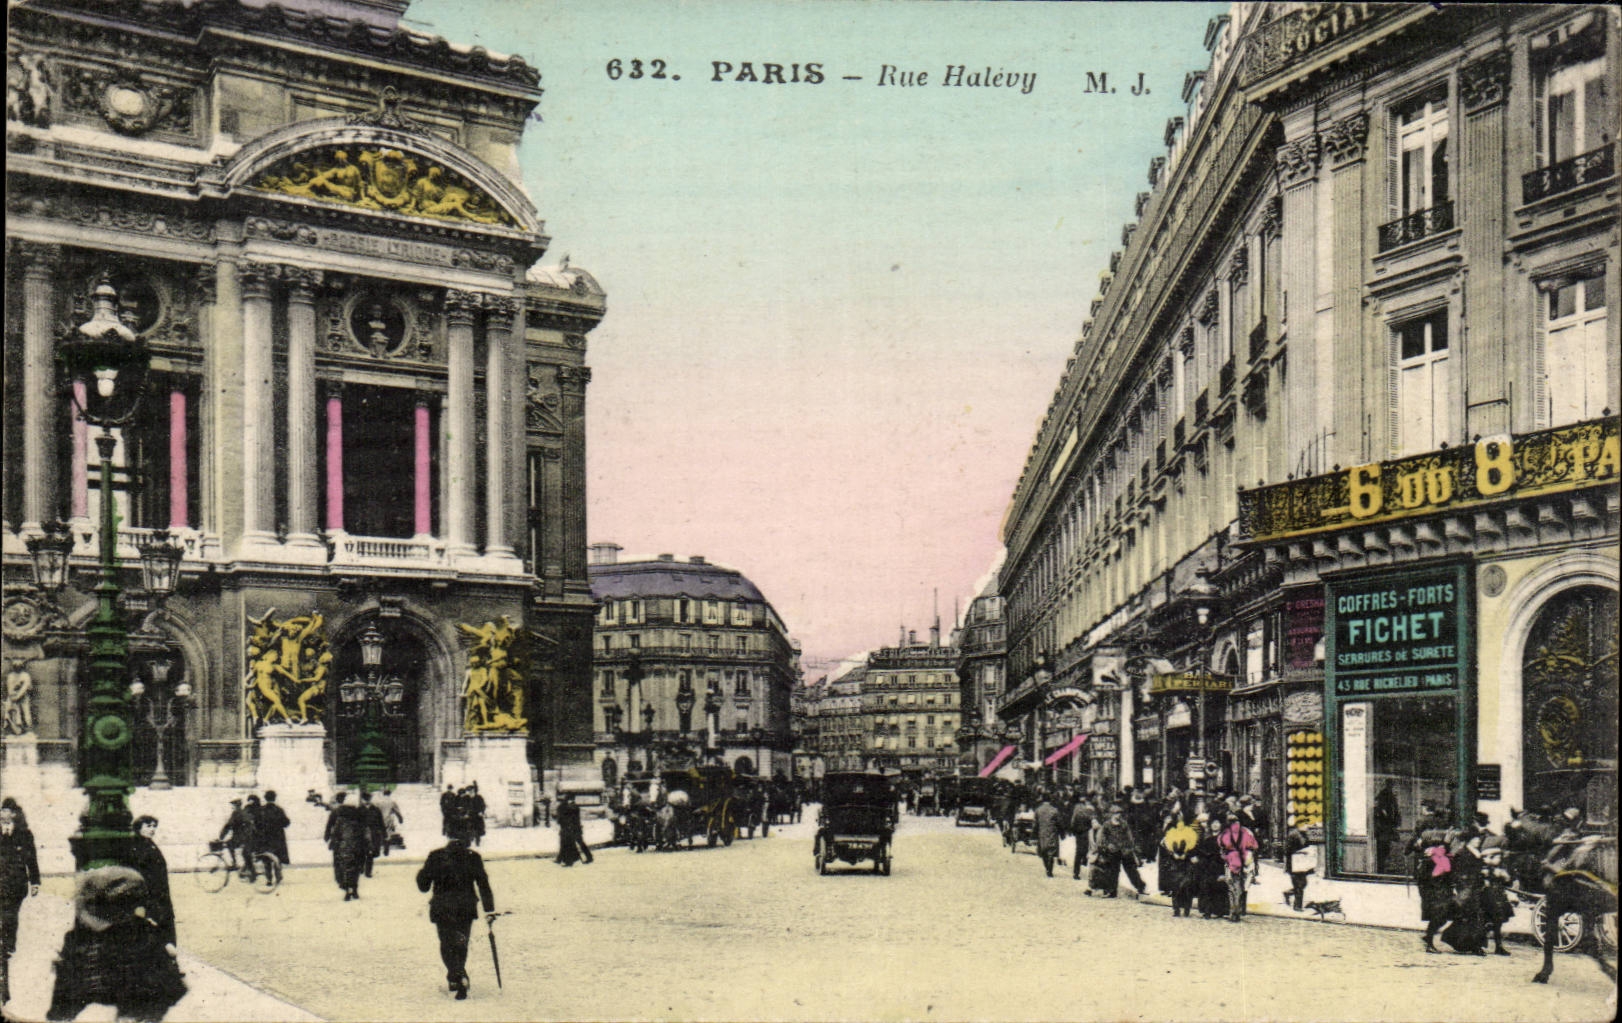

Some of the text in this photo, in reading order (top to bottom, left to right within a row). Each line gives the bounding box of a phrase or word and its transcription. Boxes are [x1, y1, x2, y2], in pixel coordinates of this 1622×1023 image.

[1350, 463, 1383, 519] 6
[1475, 433, 1514, 497] 8
[1349, 611, 1444, 645] FICHET
[1338, 650, 1392, 666] SERRURES
[1337, 679, 1351, 692] 43
[1353, 678, 1371, 691] RUE
[1425, 673, 1453, 687] PARIS
